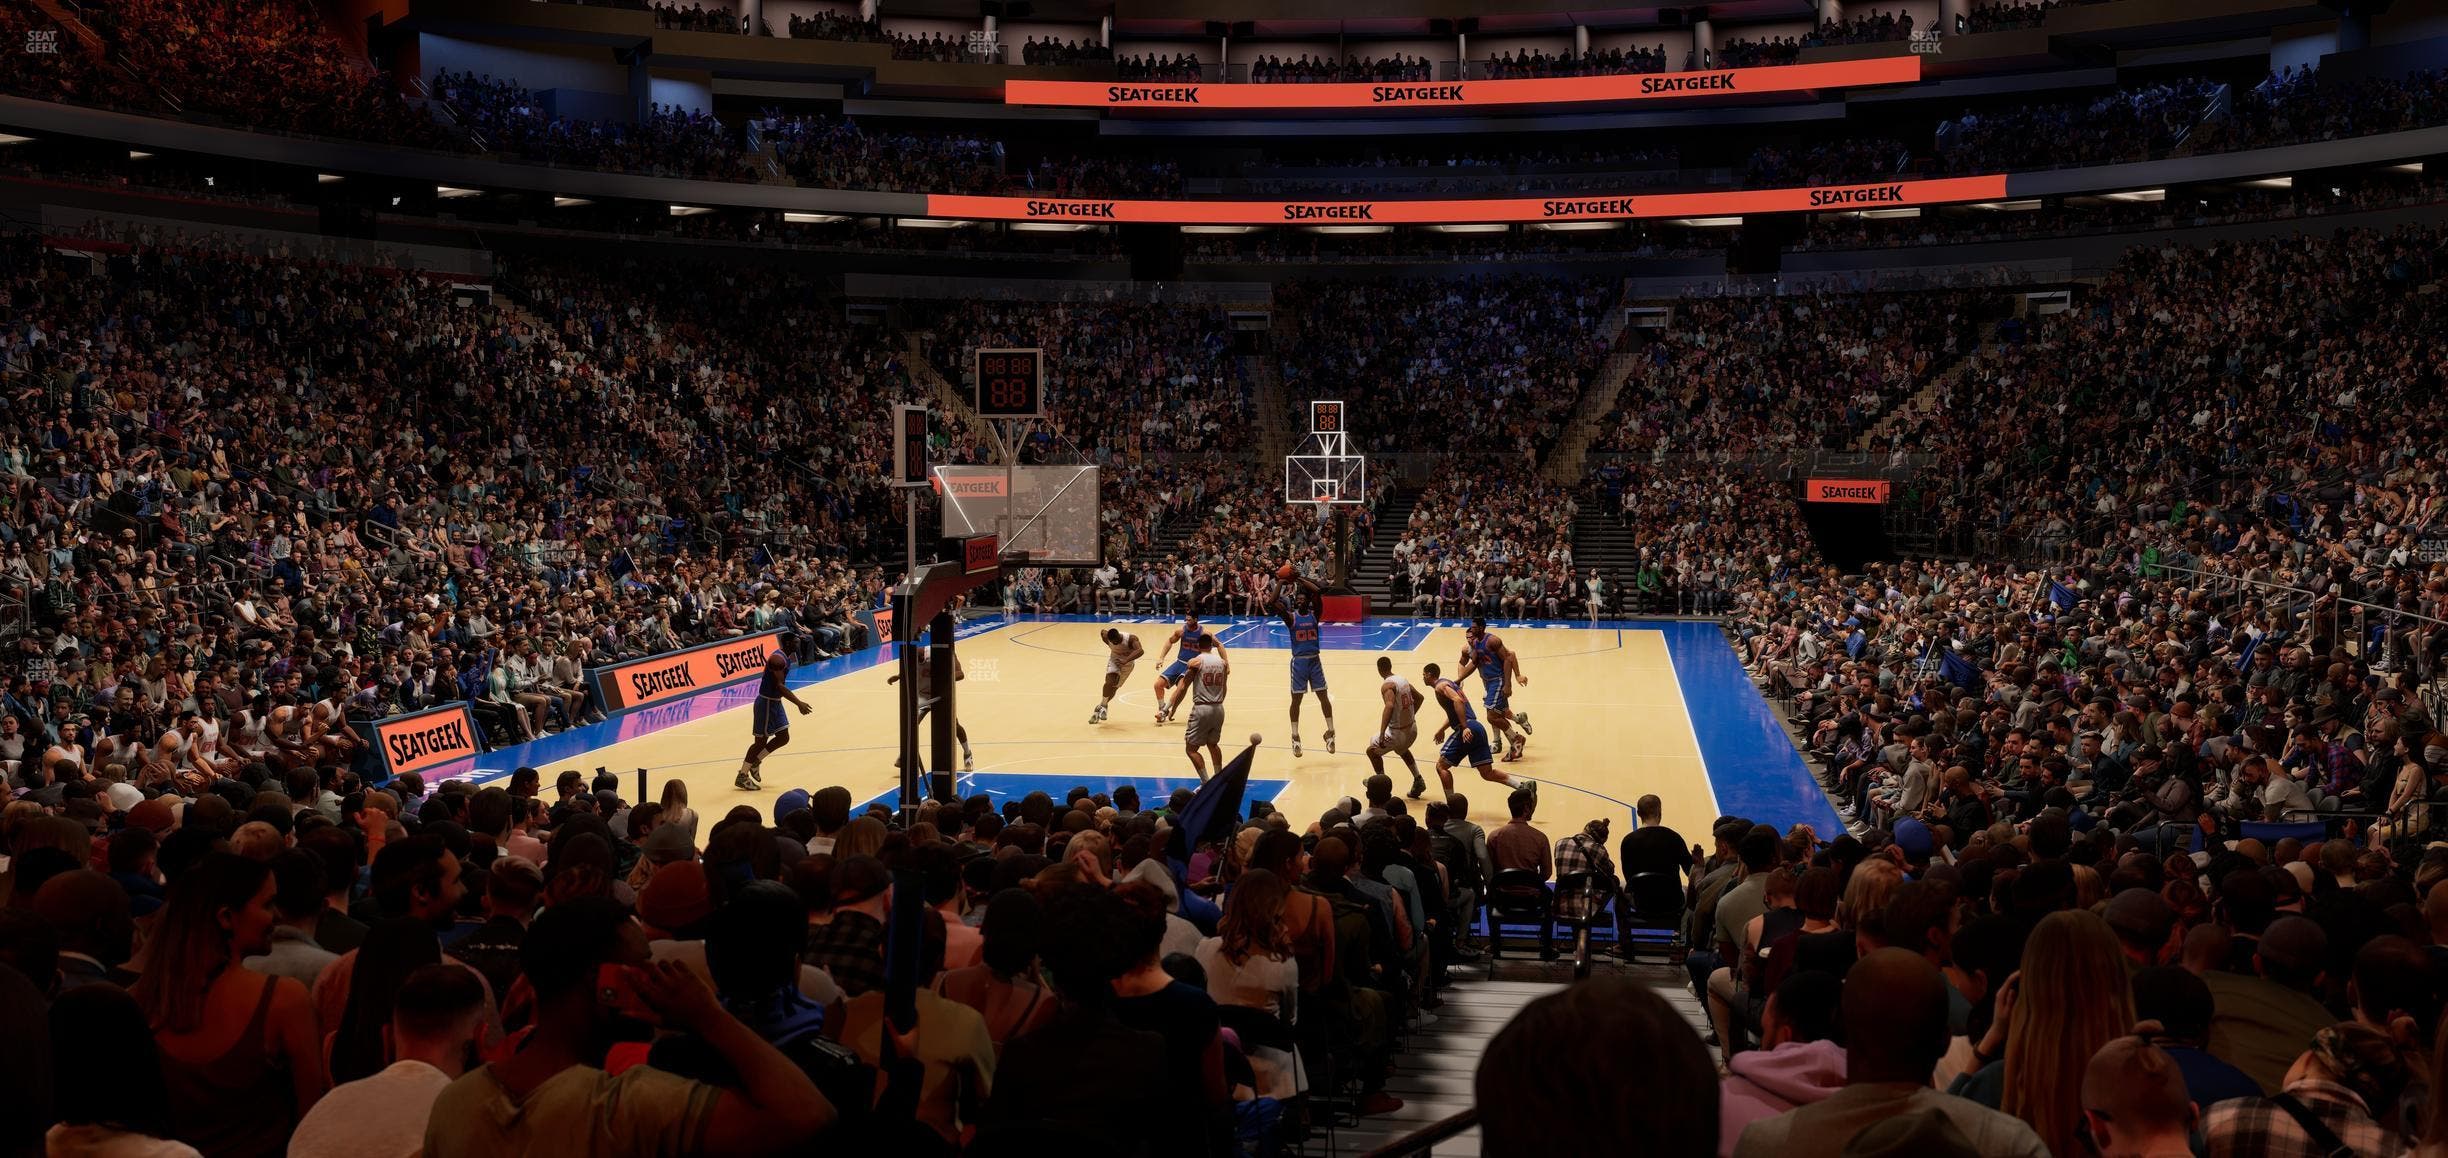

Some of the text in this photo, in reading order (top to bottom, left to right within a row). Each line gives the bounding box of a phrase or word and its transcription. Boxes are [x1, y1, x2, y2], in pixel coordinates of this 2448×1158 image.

[1108, 72, 1736, 104] SEATGEEK SEATGEEK SEATGEEK
[1026, 184, 1904, 220] SEATGEEK SEATGEEK SEATGEEK SEATGEEK
[1010, 358, 1032, 375] 88
[990, 378, 1027, 408] 88
[1319, 415, 1336, 430] 88
[1821, 485, 1877, 501] SEATGEEK
[631, 644, 768, 701] SEATGEEK SEATGEEK
[389, 718, 470, 767] SEATGEEK
